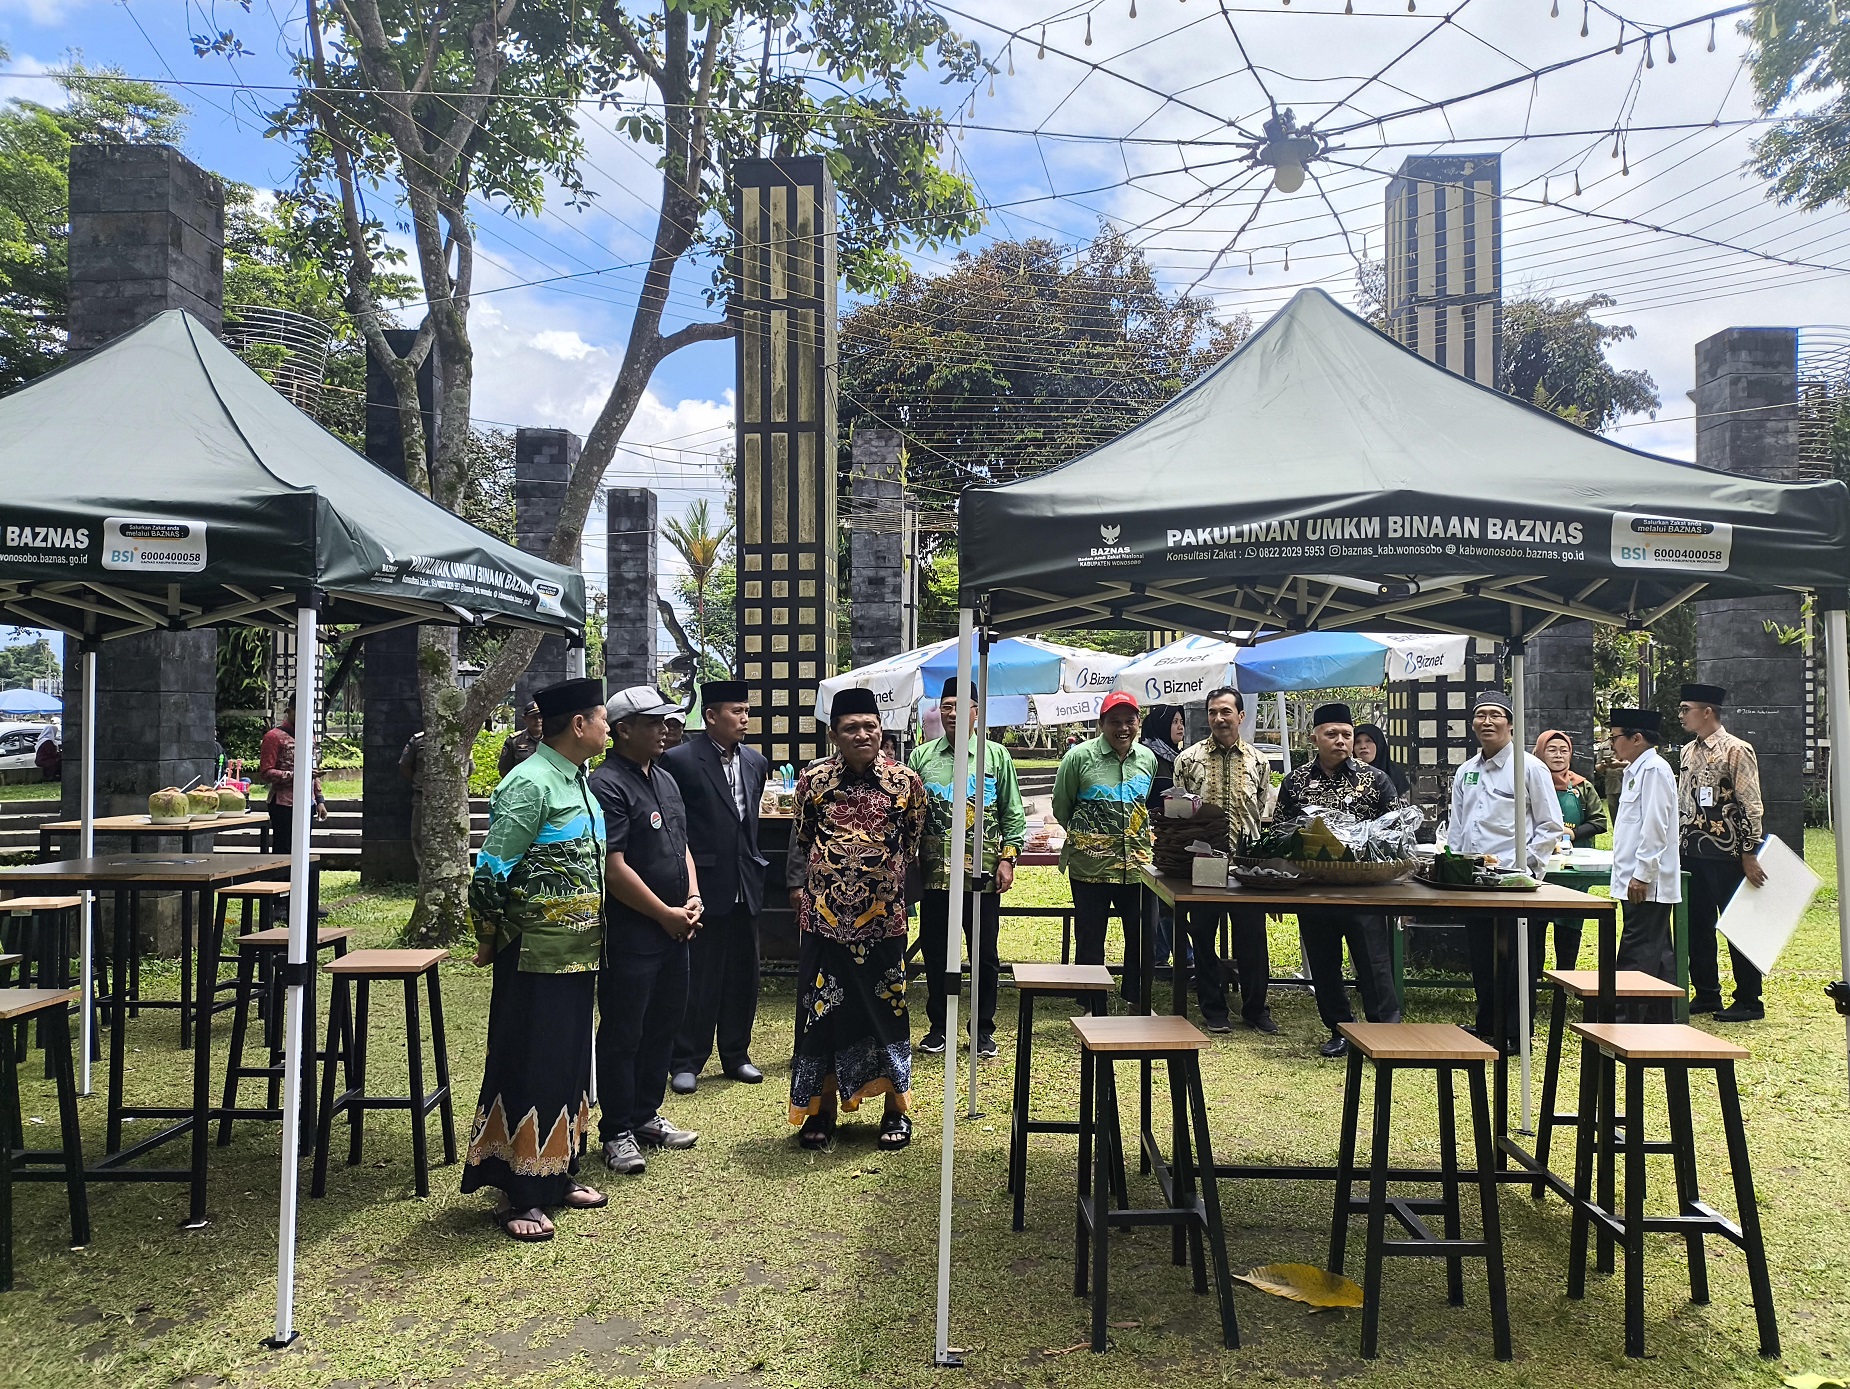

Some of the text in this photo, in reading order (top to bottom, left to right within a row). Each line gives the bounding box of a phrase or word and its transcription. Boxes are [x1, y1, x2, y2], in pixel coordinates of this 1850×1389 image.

[6, 526, 90, 549] BAZNAS
[1166, 515, 1584, 547] PAKULINAN UMKM BINAAN BAZNAS
[111, 550, 201, 562] BSI 6000400058
[1090, 546, 1131, 556] BAZNAS
[1166, 549, 1211, 561] Konsultasi
[1212, 549, 1237, 560] Zakat
[1259, 547, 1280, 558] 0822
[1281, 546, 1302, 557] 2029
[1304, 545, 1325, 556] 5953
[1621, 547, 1722, 560] BSI 6000400058
[477, 566, 506, 588] BINAAN
[1416, 653, 1444, 668] Biznet
[1164, 678, 1203, 694] Biznet
[873, 689, 894, 703] net
